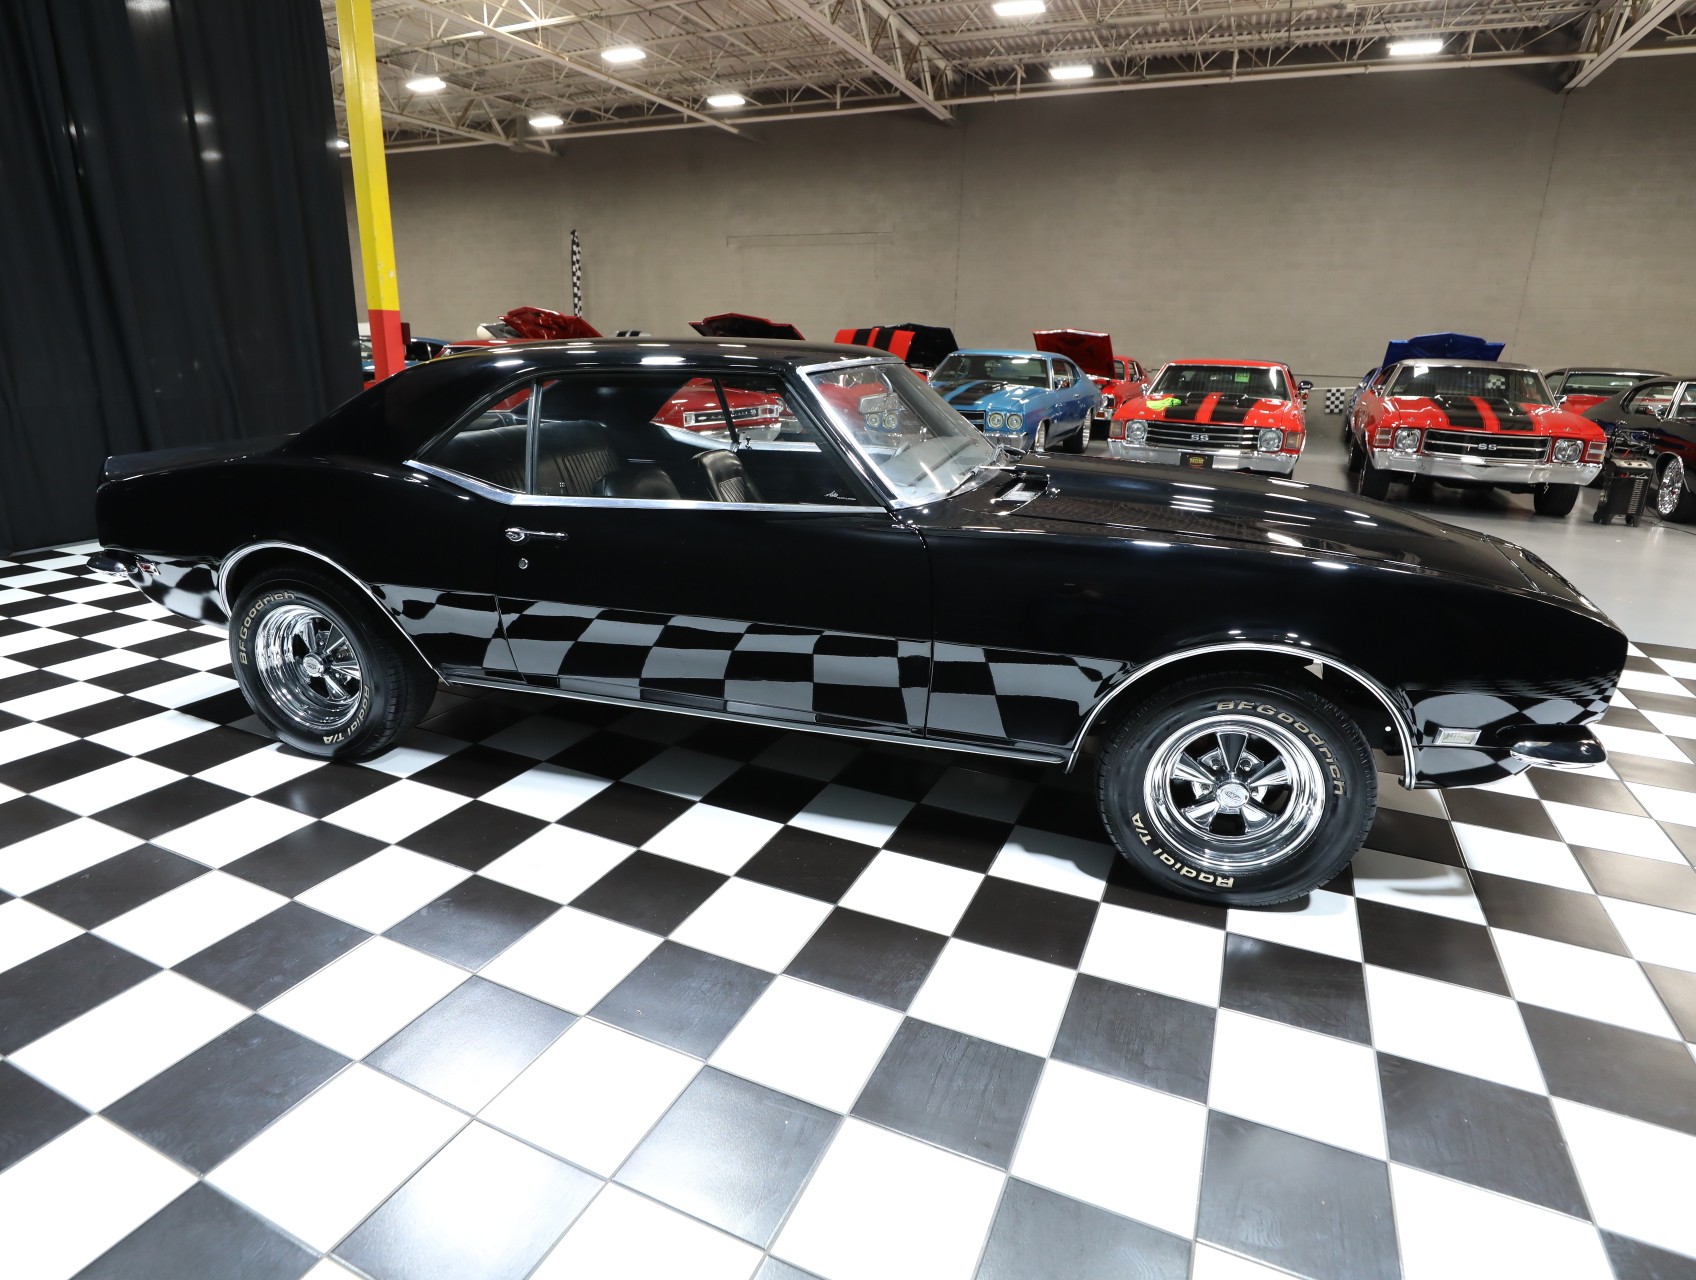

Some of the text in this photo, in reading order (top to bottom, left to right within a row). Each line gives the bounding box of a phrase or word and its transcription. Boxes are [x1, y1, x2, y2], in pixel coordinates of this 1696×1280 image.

[1478, 443, 1497, 451] SS
[239, 592, 295, 665] BFGoodrich
[322, 684, 370, 745] Radial T/A
[1216, 700, 1345, 796] BFGoodrich
[1131, 812, 1235, 888] Radial T/A
